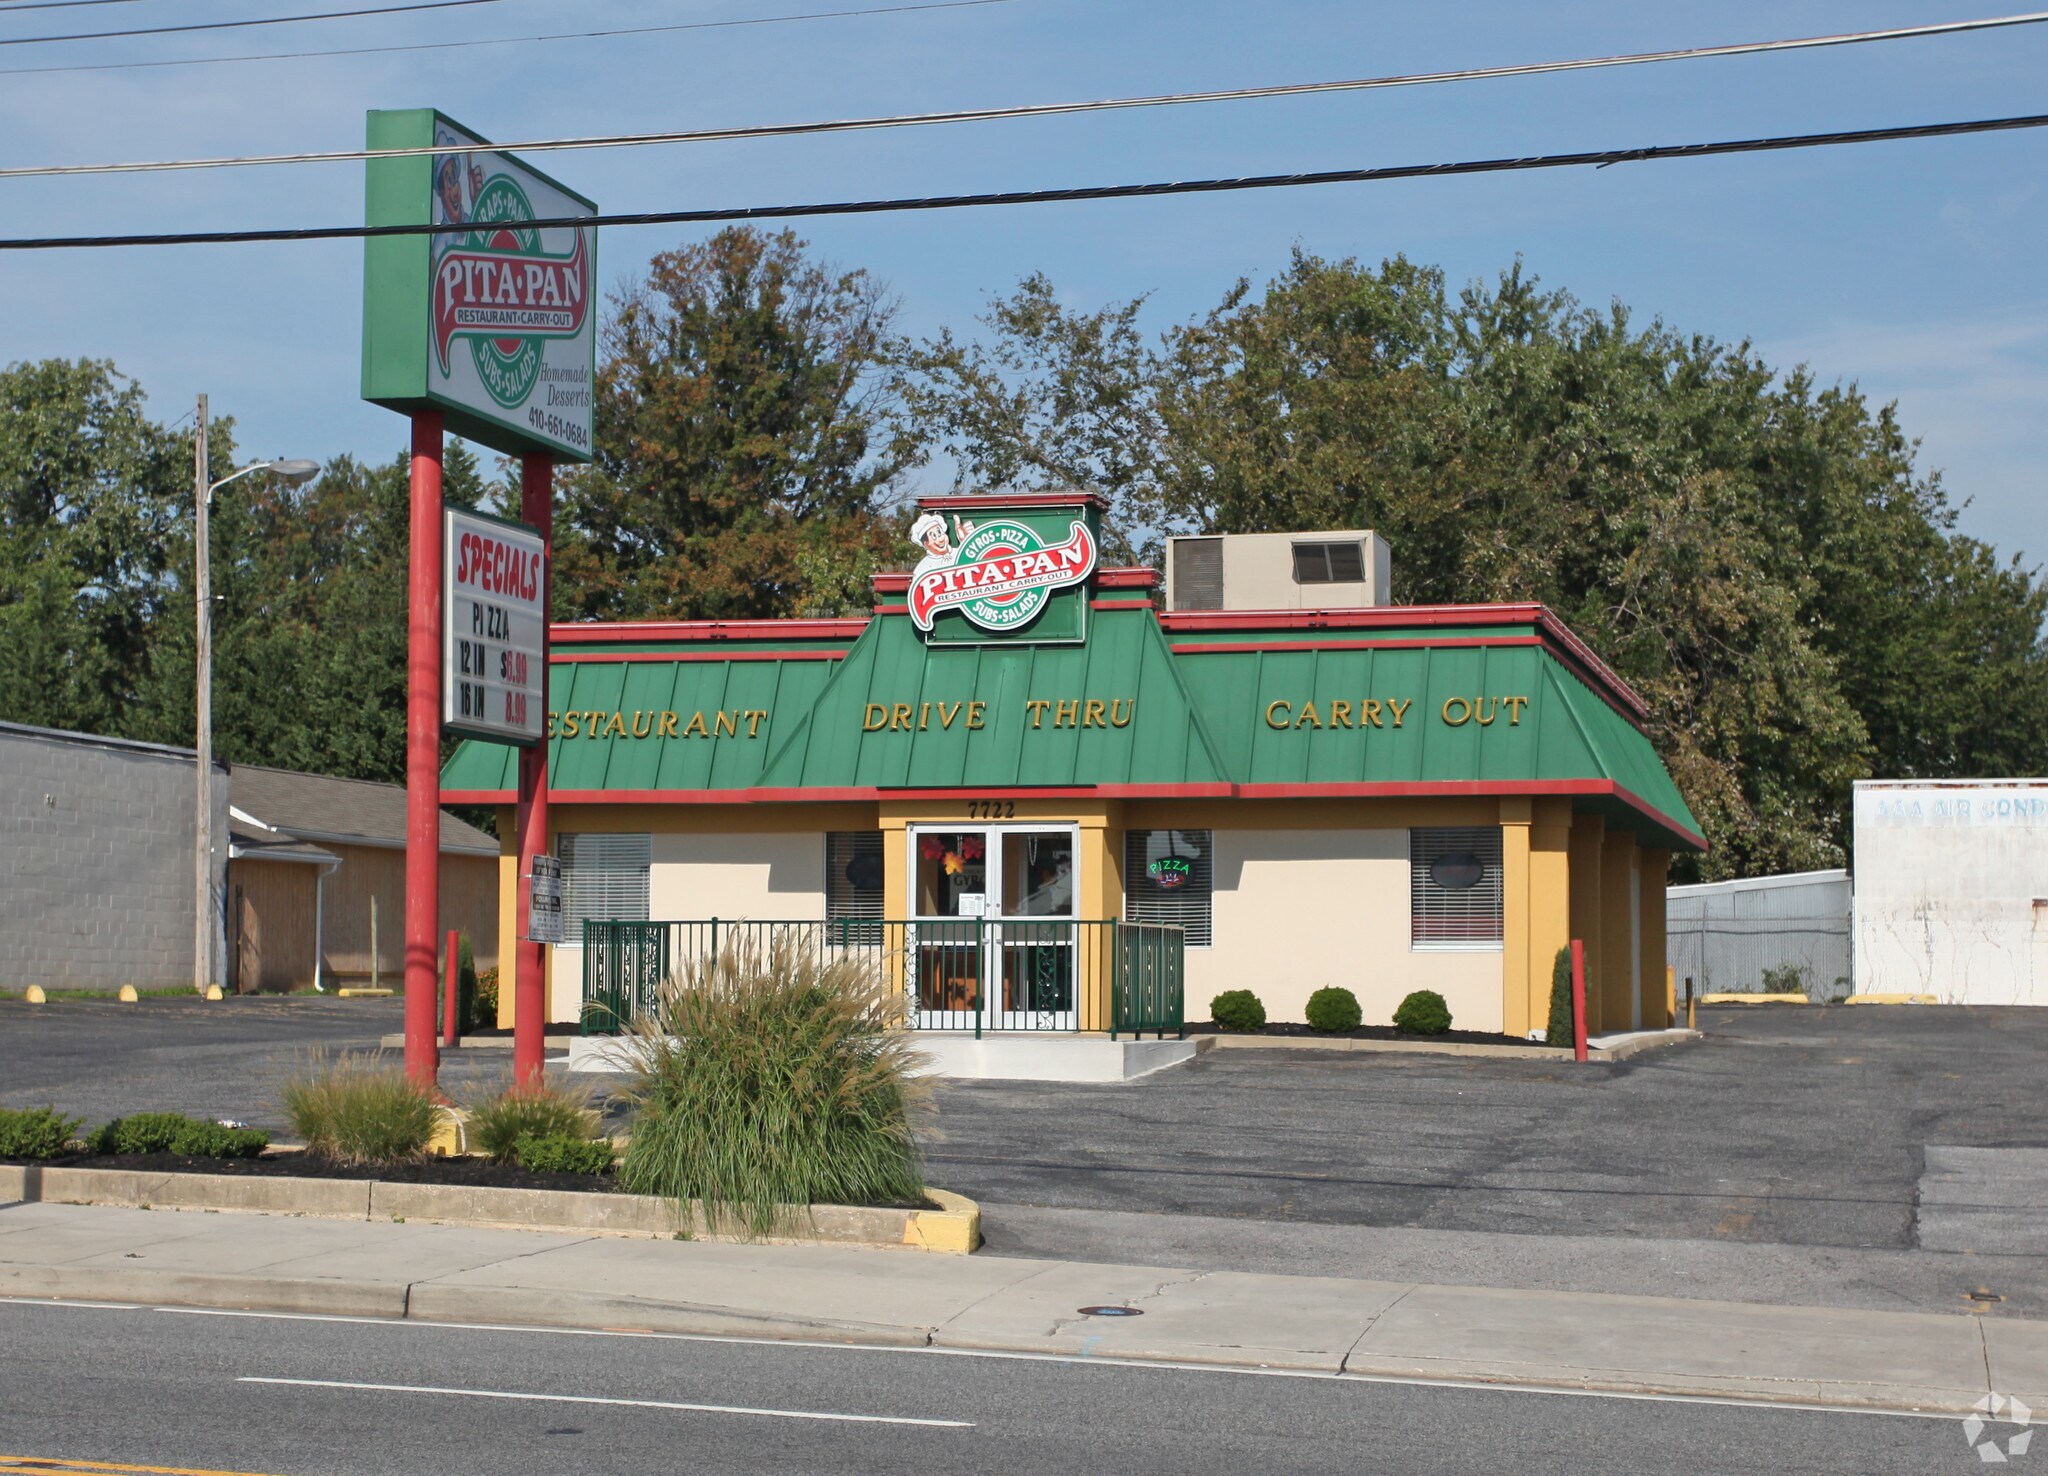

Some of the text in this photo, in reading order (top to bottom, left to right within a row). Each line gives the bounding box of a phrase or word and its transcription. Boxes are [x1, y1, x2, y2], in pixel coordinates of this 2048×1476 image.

[457, 309, 518, 324] RESTAURANT
[479, 341, 536, 397] SUBS SALADS
[540, 362, 589, 383] Homemade
[547, 383, 590, 407] Desserts
[529, 406, 588, 448] 410-661-0684
[965, 528, 1029, 559] GYROS PIZZA
[458, 532, 540, 602] SPECIALS
[938, 571, 1069, 602] RESTAURANT CARRY-OUT
[472, 602, 510, 641] PIZZA
[972, 591, 1038, 622] SUBS SALADS
[459, 640, 527, 685] 12 IN $6.99
[459, 682, 527, 725] 16 IN 8.99
[548, 696, 1530, 740] ESTAURANT DRIVE THRU CARRY OUT
[968, 800, 1015, 819] 7722
[1934, 798, 1972, 817] AIR
[1150, 860, 1189, 875] PIZZA
